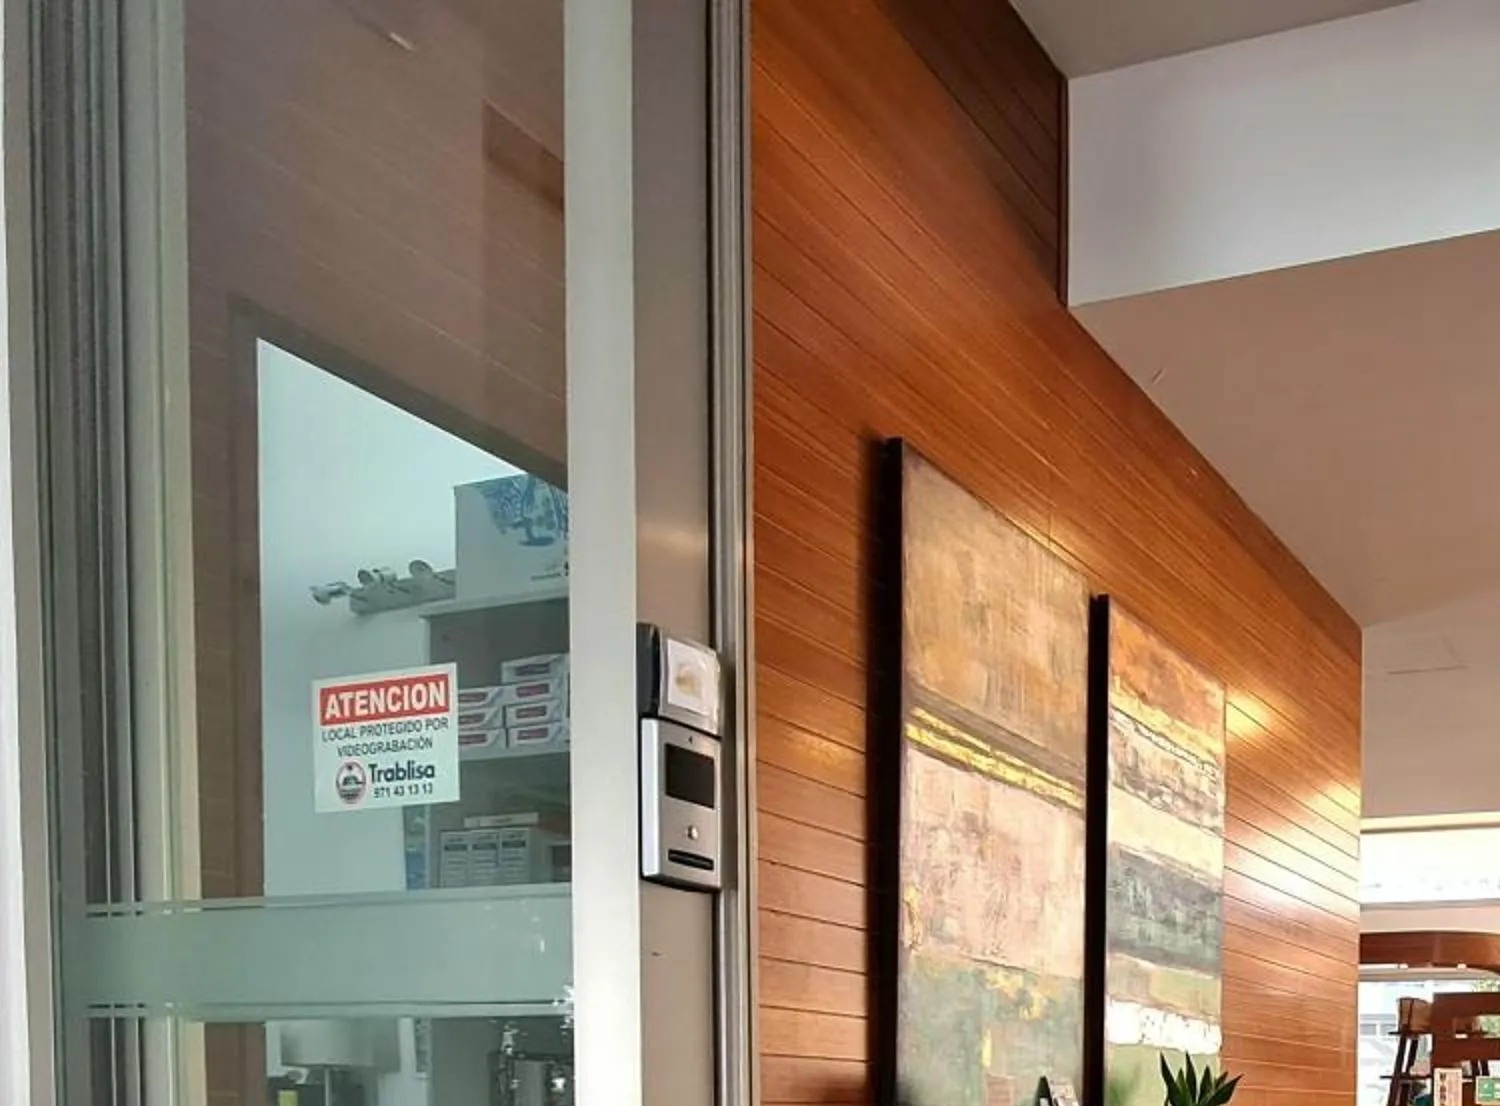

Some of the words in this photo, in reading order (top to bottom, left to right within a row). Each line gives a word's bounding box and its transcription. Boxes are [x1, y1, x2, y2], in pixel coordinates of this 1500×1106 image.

[325, 681, 446, 719] ATENCION
[321, 727, 357, 742] LOCAL
[359, 720, 423, 738] PROTEGIDO
[426, 717, 449, 731] POR
[368, 760, 436, 783] Trablisa
